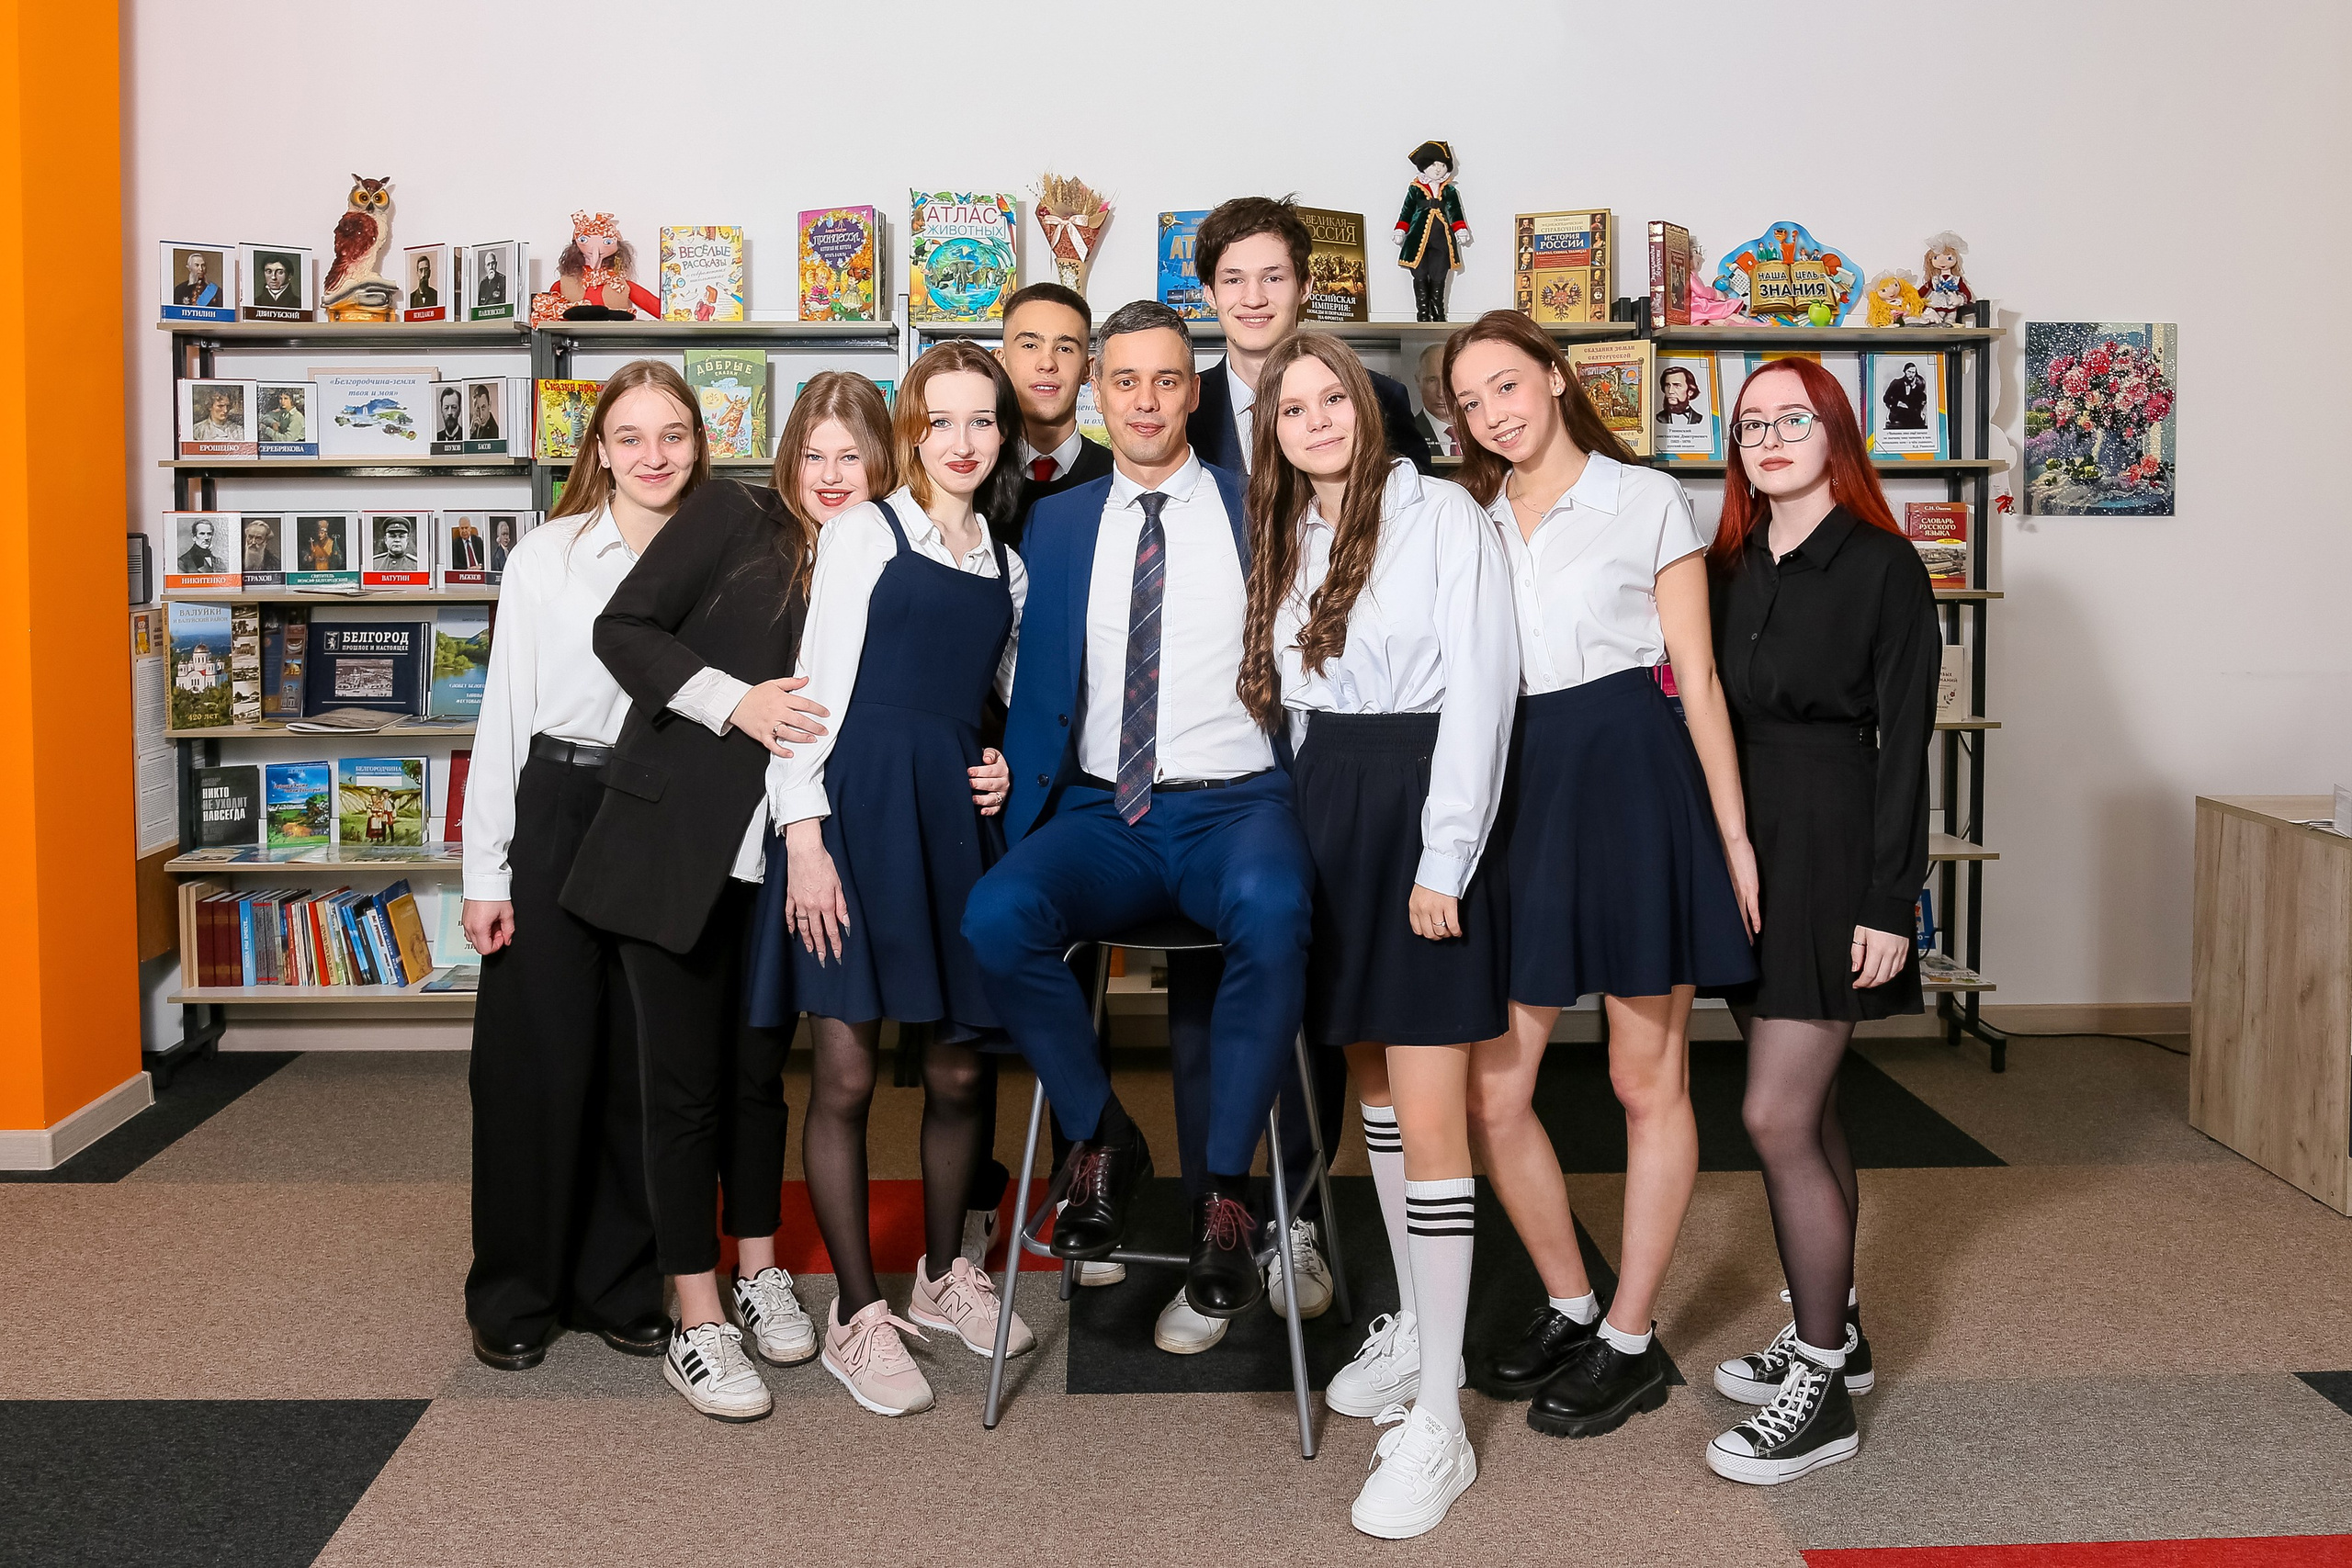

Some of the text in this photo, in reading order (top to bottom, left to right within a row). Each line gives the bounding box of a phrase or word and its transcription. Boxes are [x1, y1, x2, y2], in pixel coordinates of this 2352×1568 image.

[926, 207, 998, 224] АТЛАС
[1306, 214, 1347, 228] ВЕЛИКАЯ
[927, 225, 1004, 237] ЖИВОТНЫХ
[1303, 221, 1357, 243] ОССИЯ
[678, 243, 731, 258] ВЕСЁЛЫЕ
[1540, 239, 1584, 250] РОССИИ
[682, 258, 727, 270] РАССКАЗЫ
[1758, 271, 1787, 280] НАША
[1759, 283, 1826, 297] ЗНАНИЯ
[1309, 293, 1356, 305] ОССИЙСКАЯ
[1311, 301, 1351, 312] ИМПЕРИЯ:
[181, 309, 216, 318] ПУТИЛИН
[255, 310, 300, 320] ДВИГУБСКИЙ
[329, 377, 416, 387] «Белгородчина-земля
[544, 379, 576, 392] Сказки
[578, 383, 595, 394] про
[198, 444, 240, 452] ЕРОШЕНКО
[181, 577, 227, 585] НИКИТЕНКО
[179, 607, 221, 616] ВАЛУЙКИ
[342, 631, 410, 645] БЕЛГОРОД
[187, 713, 202, 721] 420
[202, 786, 230, 799] НИКТО
[202, 796, 248, 810] НЕ УХОДИТ
[202, 808, 246, 821] НАВСЕГДА
